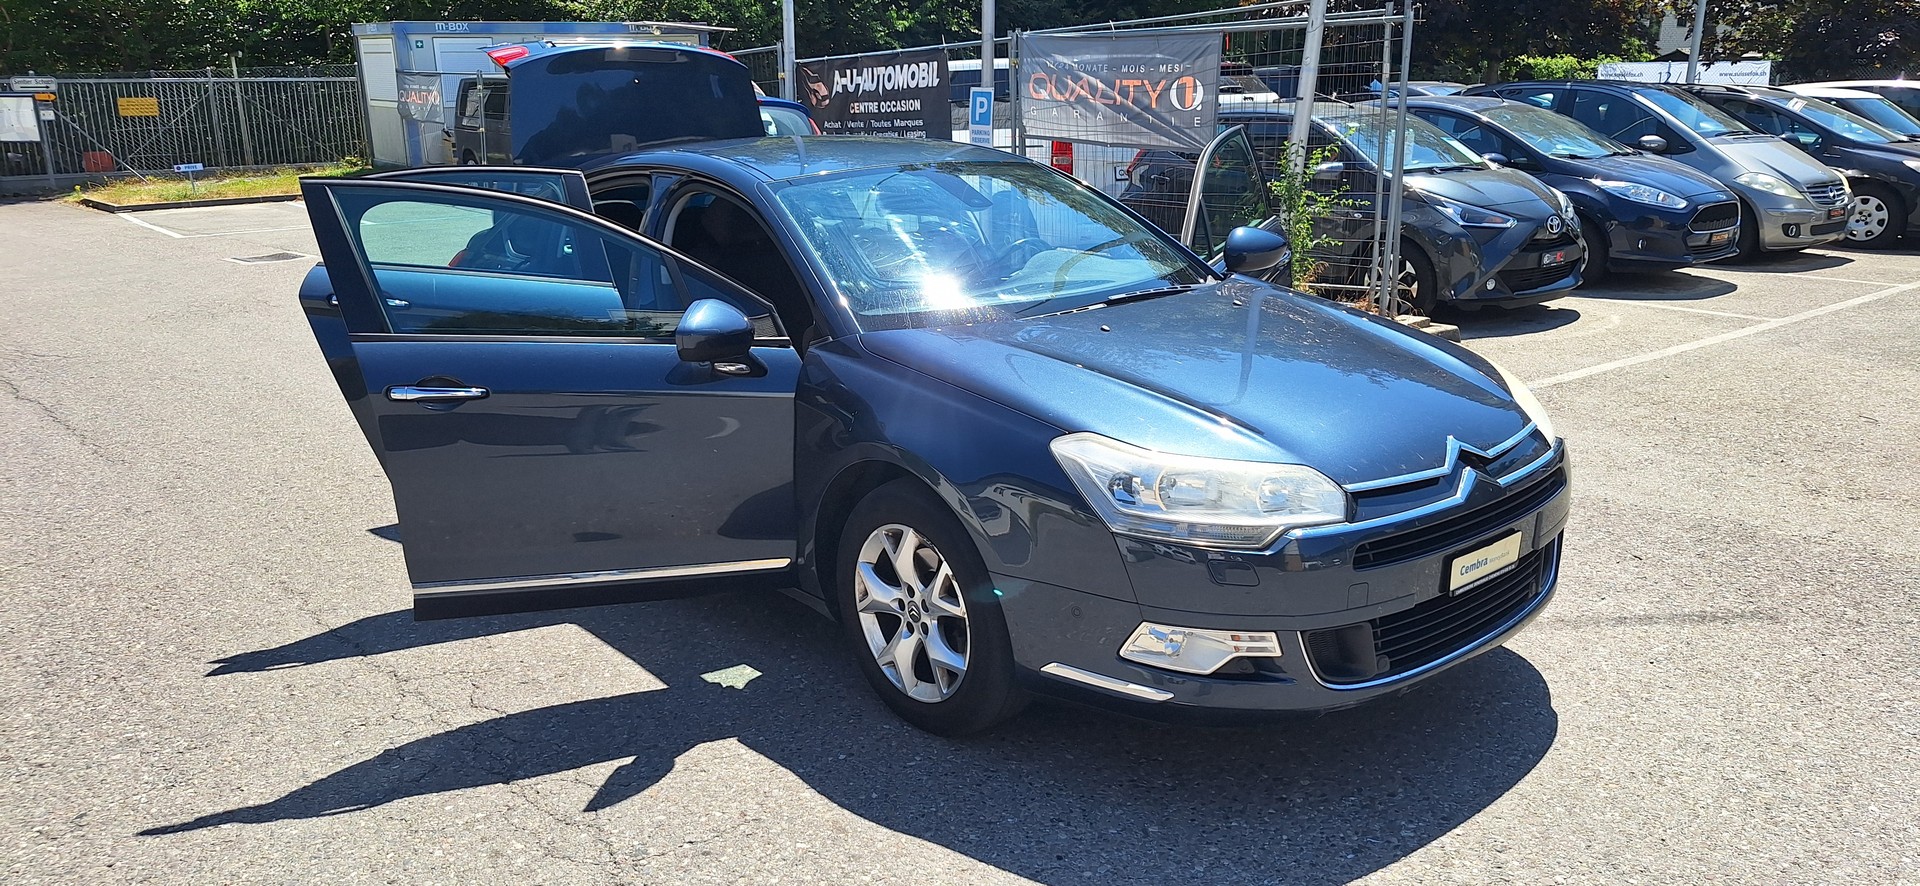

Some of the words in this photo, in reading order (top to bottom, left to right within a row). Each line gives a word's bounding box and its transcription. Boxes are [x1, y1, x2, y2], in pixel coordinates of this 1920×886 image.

[1121, 63, 1146, 73] MOIS
[831, 61, 940, 99] A-U-AUTOMOBIL
[399, 90, 431, 104] QUALITY
[1028, 72, 1166, 109] QUALITY
[849, 101, 879, 114] CENTRE
[880, 98, 921, 113] OCCASION
[975, 96, 988, 122] P
[823, 120, 842, 129] Achat
[847, 120, 865, 129] Vente
[870, 119, 892, 128] Toutes
[893, 118, 924, 128] Marques
[903, 129, 927, 139] Leasing
[1460, 557, 1488, 576] Cembra
